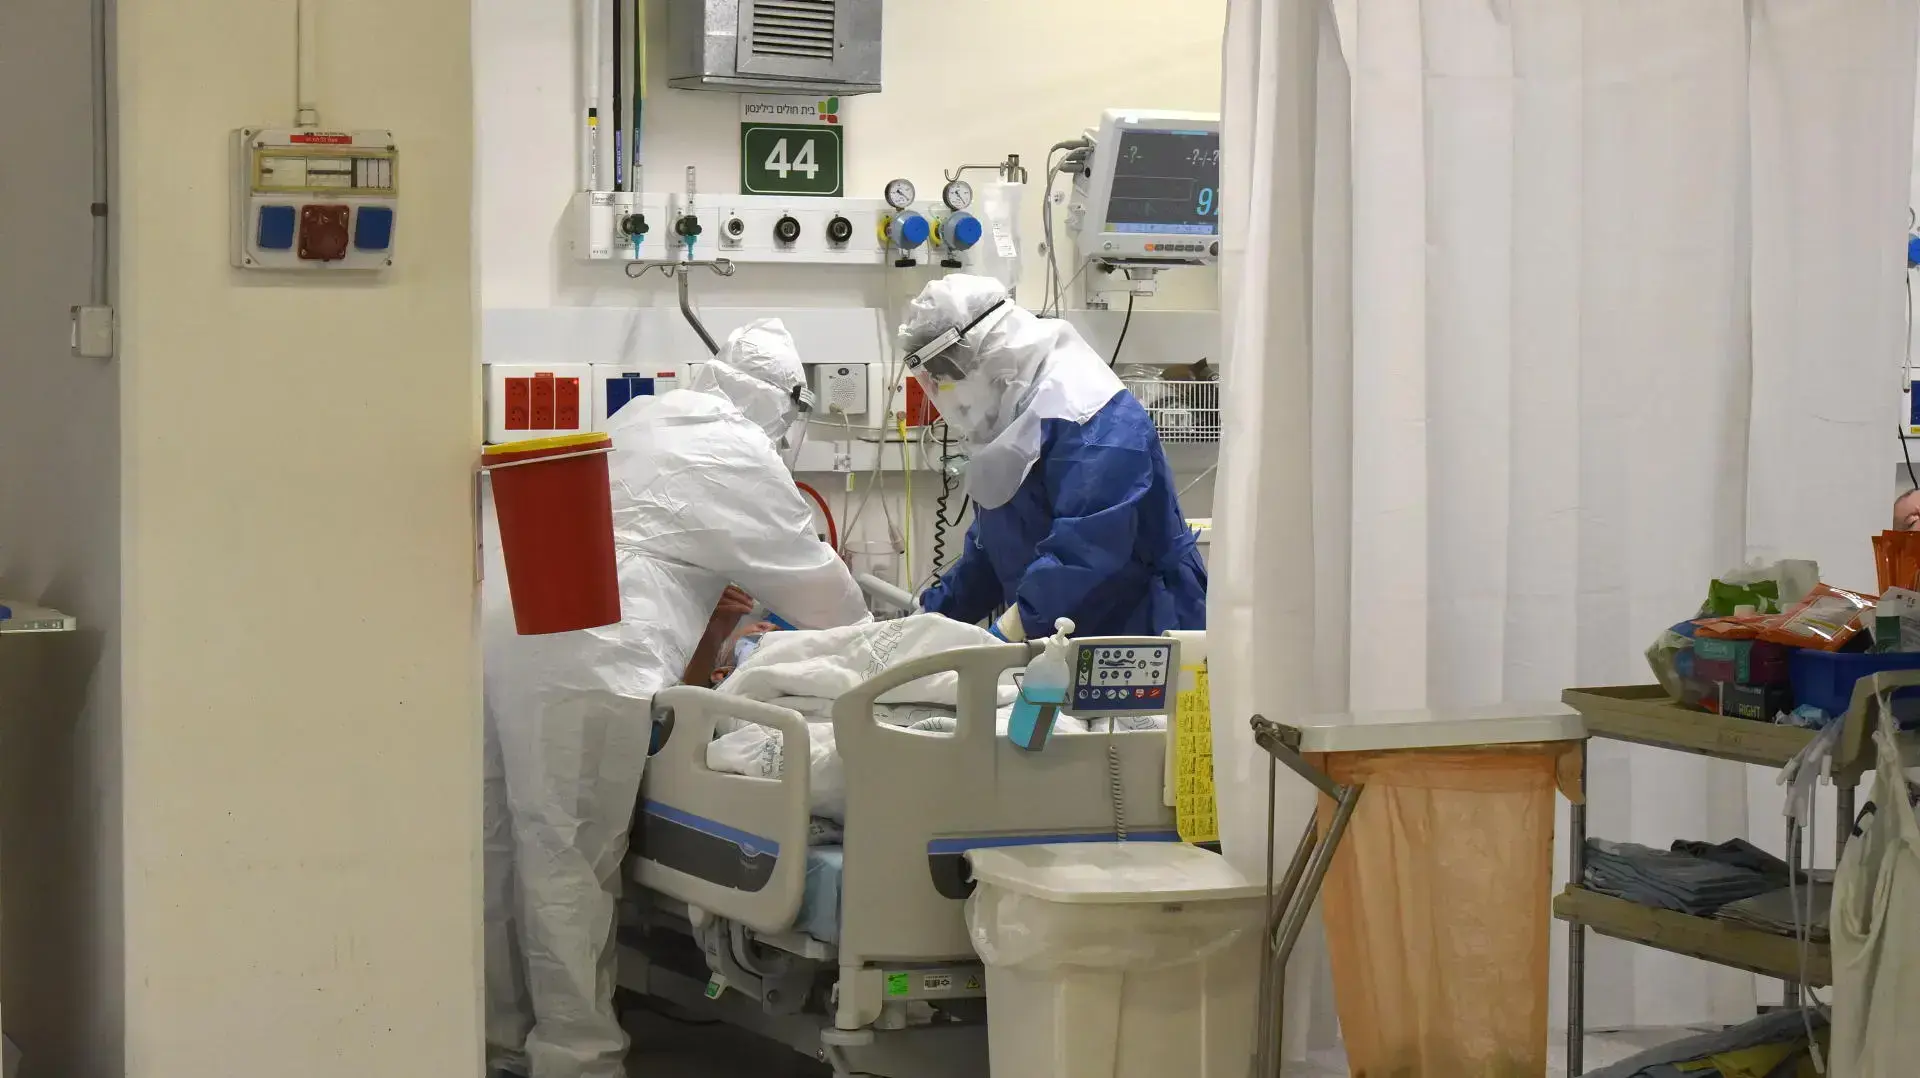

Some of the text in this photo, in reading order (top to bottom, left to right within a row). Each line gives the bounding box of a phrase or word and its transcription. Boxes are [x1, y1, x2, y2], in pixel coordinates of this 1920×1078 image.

[745, 103, 816, 115] בית חולים בילינסון
[764, 138, 819, 179] 44
[1196, 187, 1219, 216] 9
[1738, 703, 1761, 719] RIGHT
